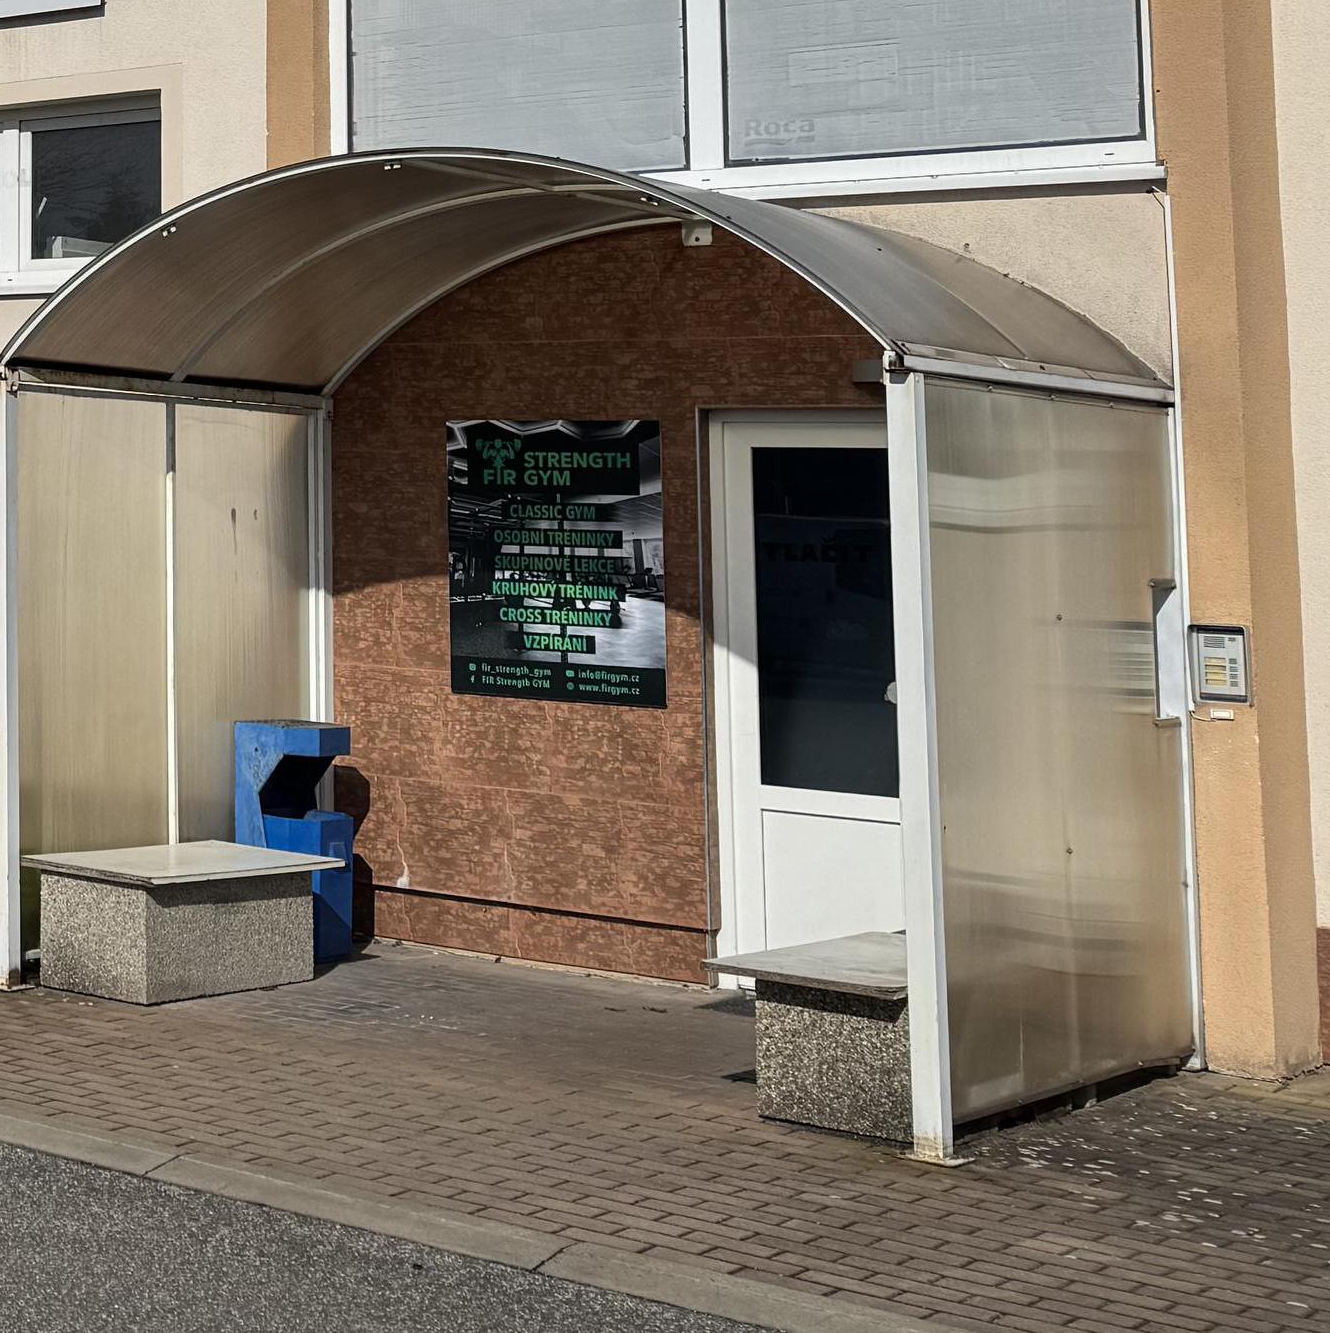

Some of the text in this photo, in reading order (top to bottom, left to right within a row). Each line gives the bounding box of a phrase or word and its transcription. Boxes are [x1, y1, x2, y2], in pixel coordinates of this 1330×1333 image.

[744, 119, 815, 137] Roca
[524, 452, 630, 468] STRENGTH
[483, 468, 571, 486] FIR GYM
[510, 504, 595, 520] CLASSIC GYM
[494, 527, 614, 546] OSOBNÍ TRÉNINKY
[495, 554, 615, 573] SKUPINOVÉ LEKCE
[492, 580, 618, 600] KRUHOVÝ TRÉNINK
[500, 607, 612, 626] CROSS TRÉNINKY
[496, 676, 531, 689] Strength
[532, 678, 551, 688] GYM
[578, 669, 640, 683] info@firgym.cz
[579, 684, 640, 695] www.firgym.cz
